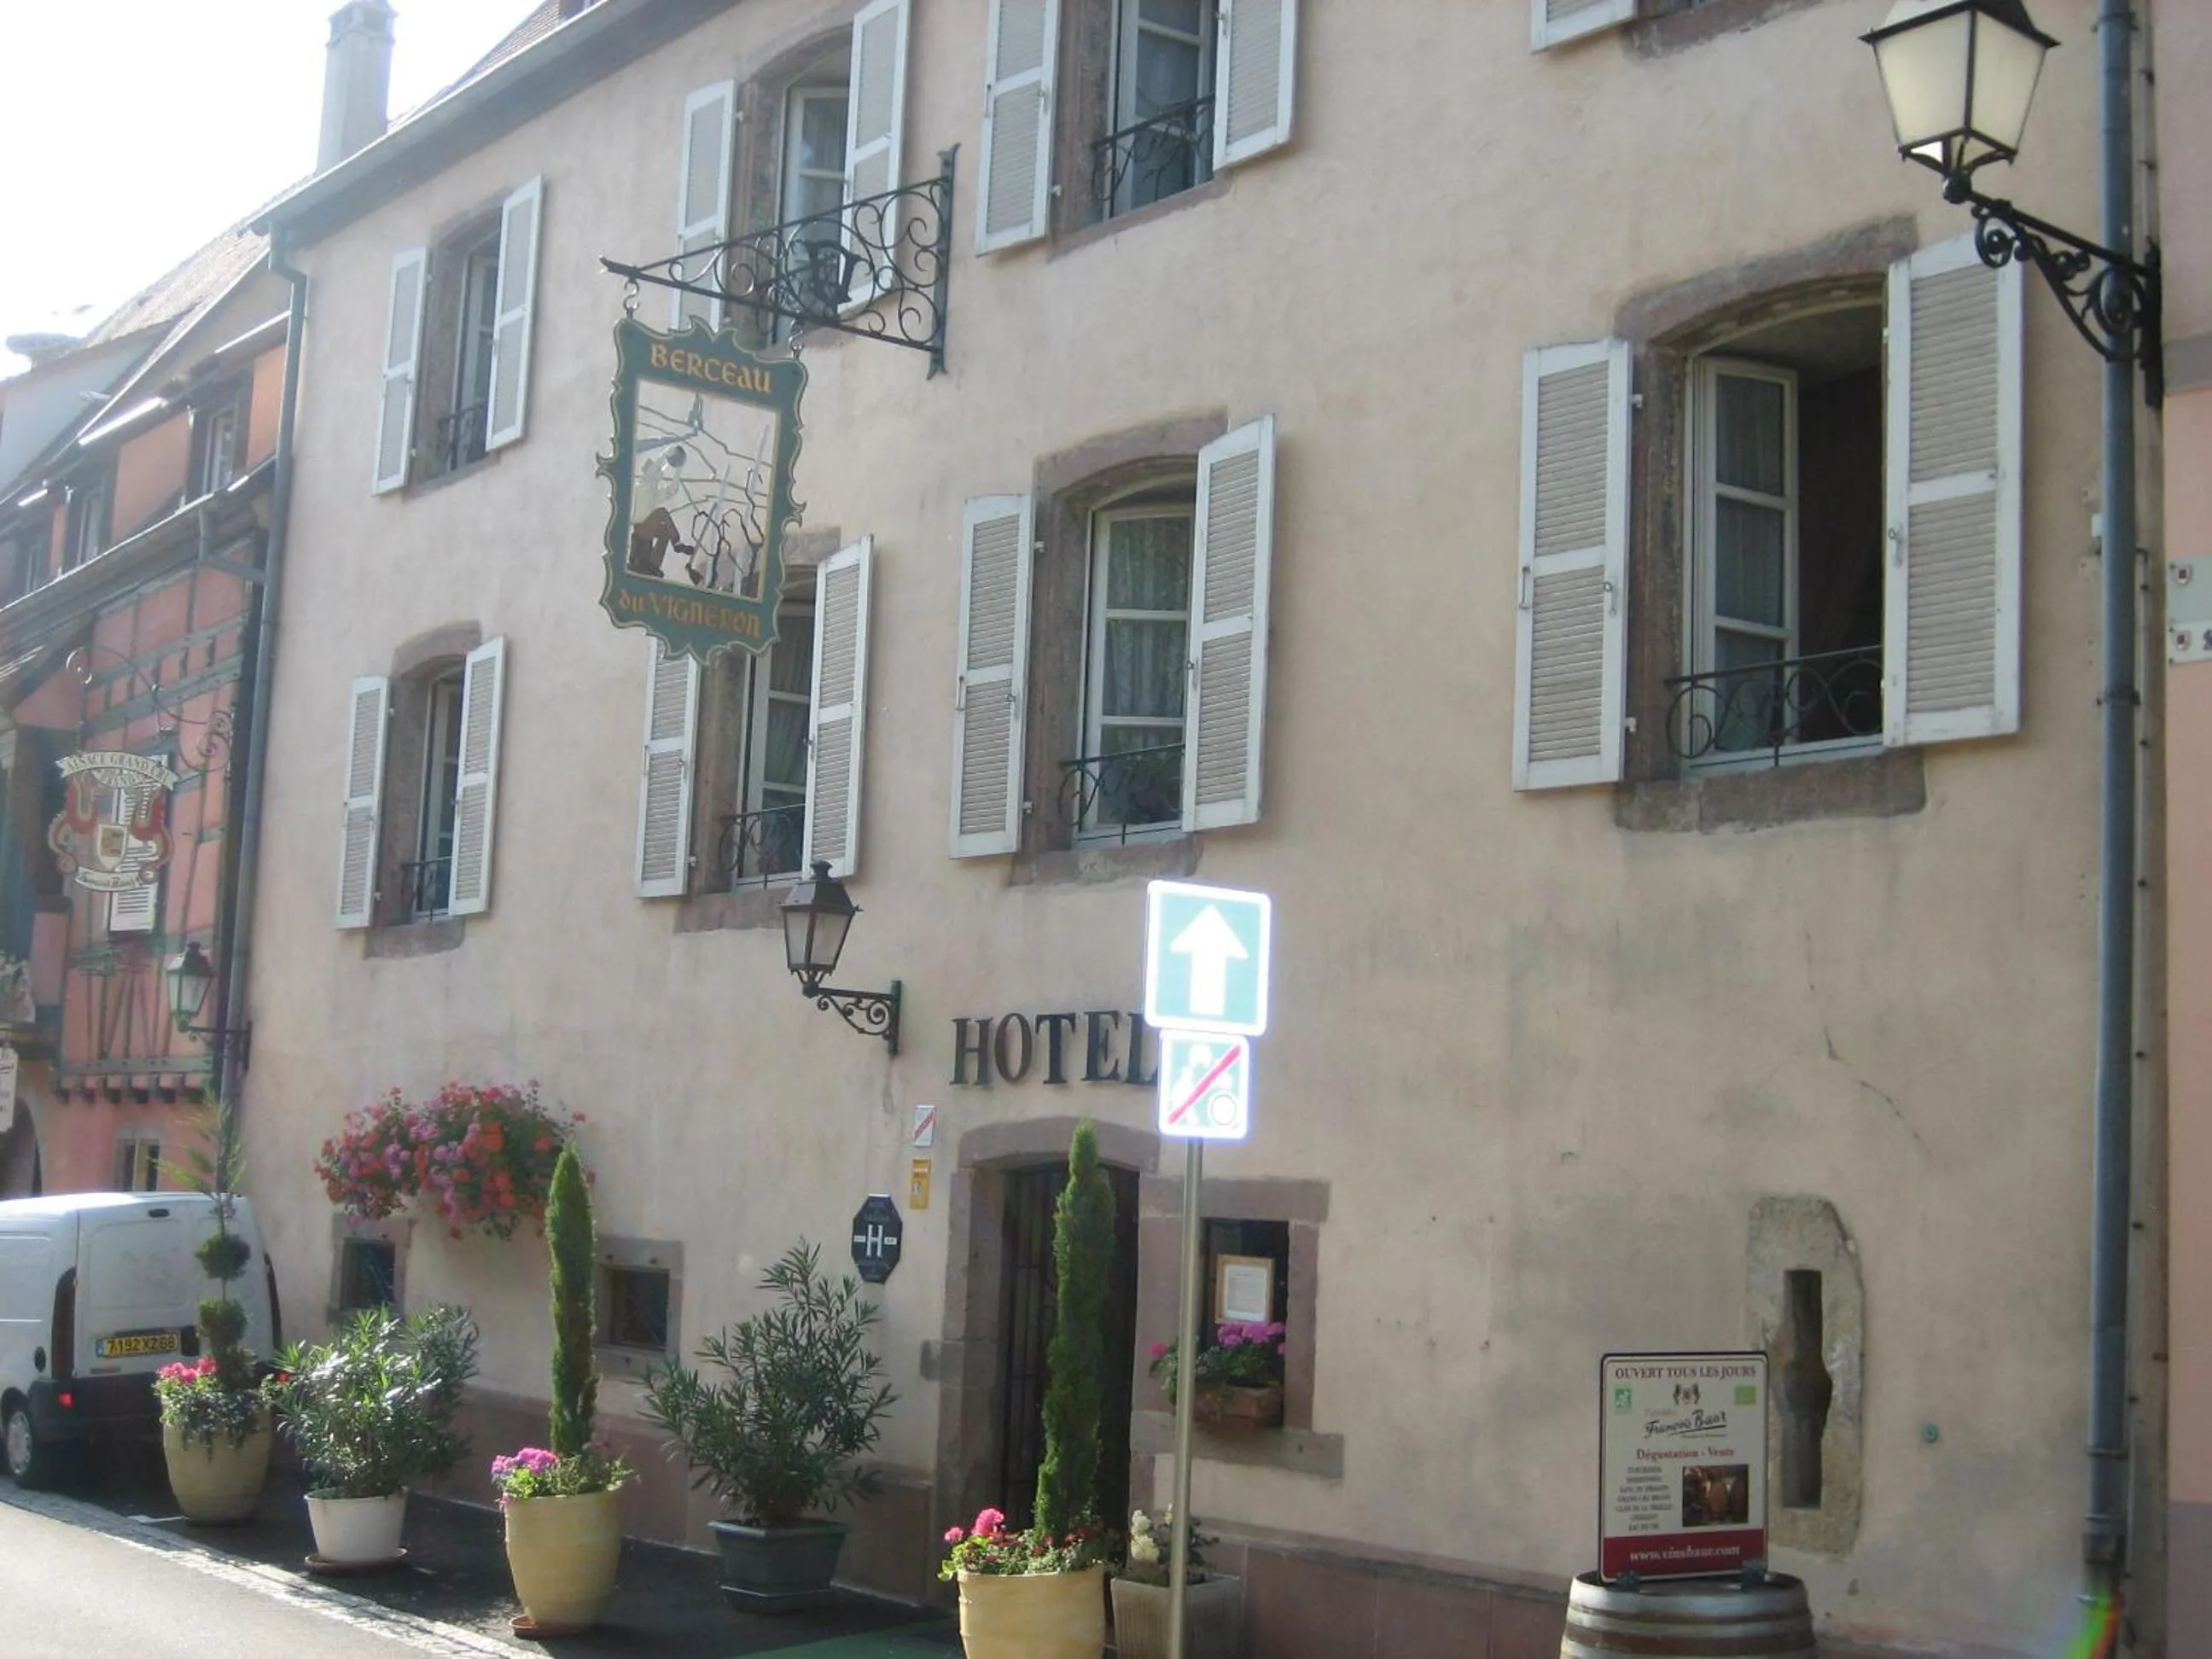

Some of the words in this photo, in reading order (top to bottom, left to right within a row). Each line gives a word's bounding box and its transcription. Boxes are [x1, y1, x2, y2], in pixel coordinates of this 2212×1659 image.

[949, 1010, 1158, 1086] HOTEL
[866, 1224, 883, 1258] H
[1615, 1367, 1663, 1380] OUVERT
[1667, 1366, 1697, 1378] TOUS
[1699, 1366, 1720, 1378] LES
[1720, 1365, 1756, 1380] JOURS
